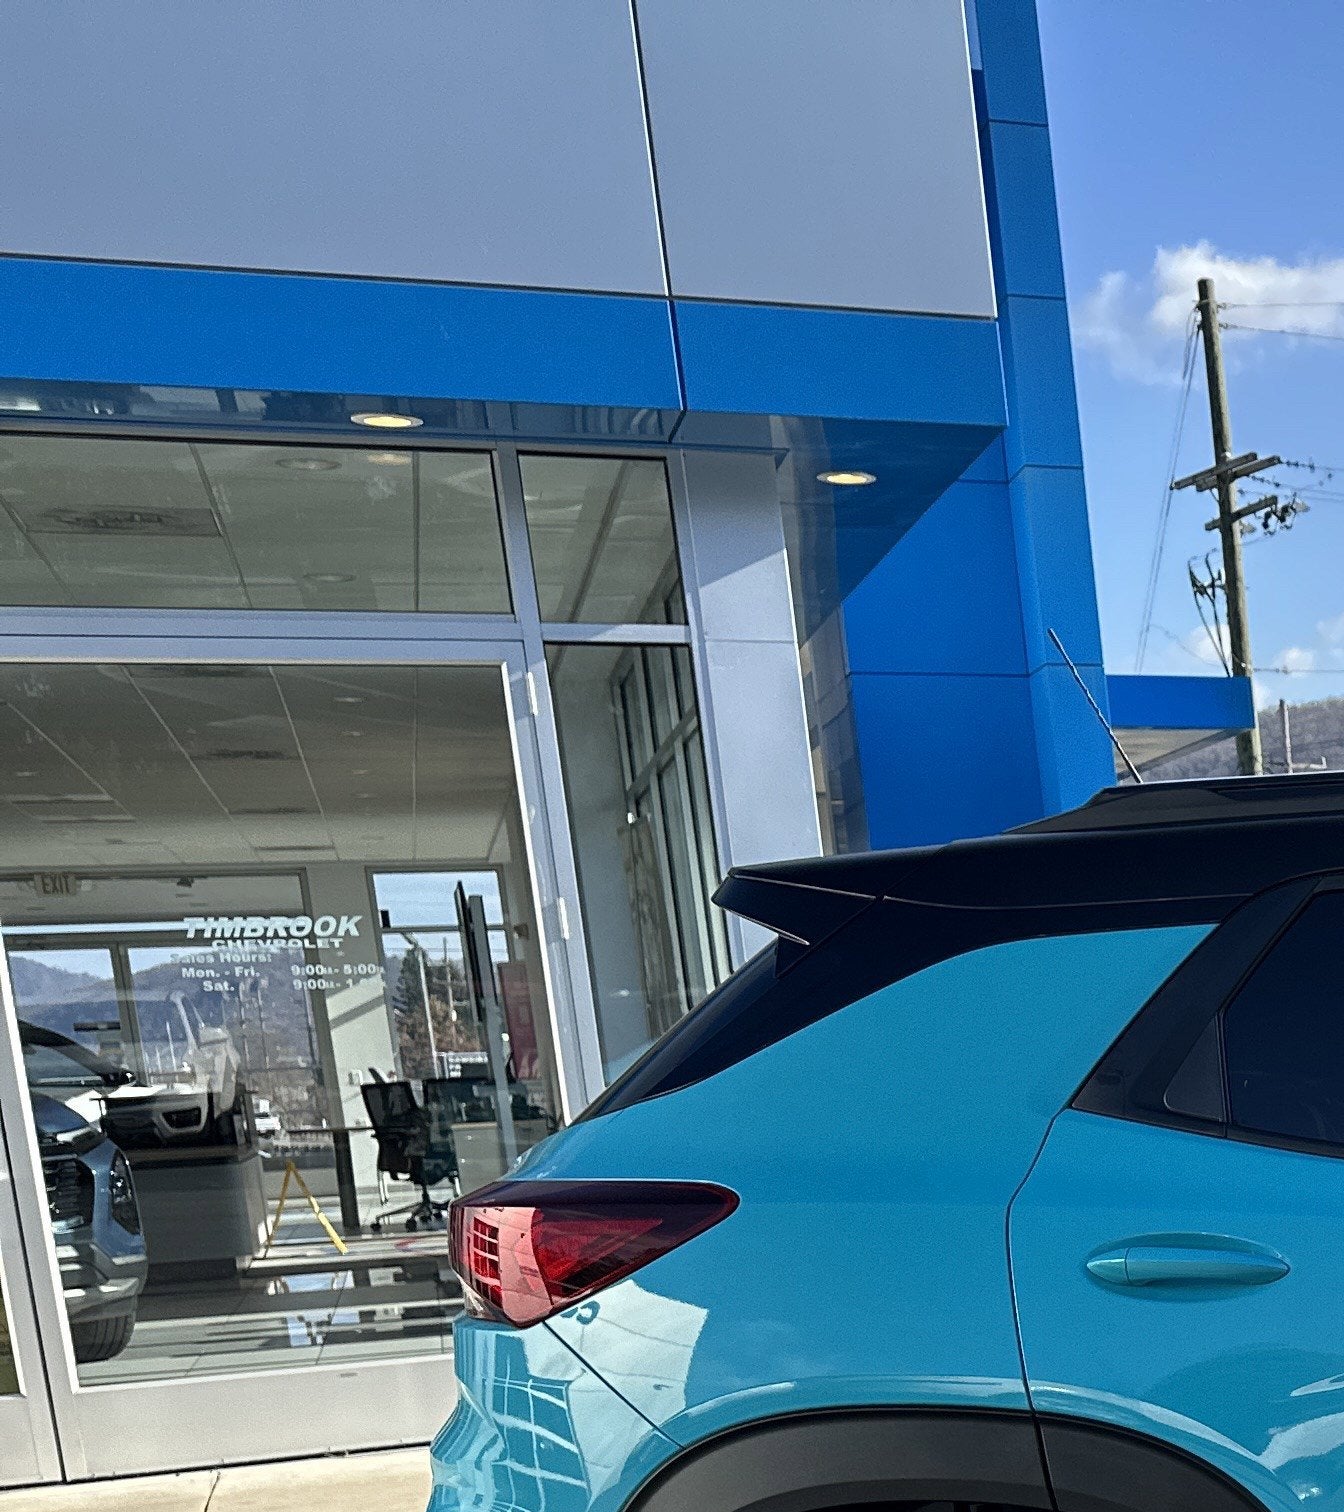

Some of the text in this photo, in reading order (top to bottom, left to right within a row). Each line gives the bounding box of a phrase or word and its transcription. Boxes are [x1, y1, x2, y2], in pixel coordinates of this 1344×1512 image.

[183, 915, 363, 939] TIMBROOK
[211, 937, 344, 950] CHEVROLET
[219, 953, 272, 963] Hours:
[182, 967, 220, 978] Mon.
[234, 966, 261, 978] Fri.
[203, 981, 235, 992] Sat.
